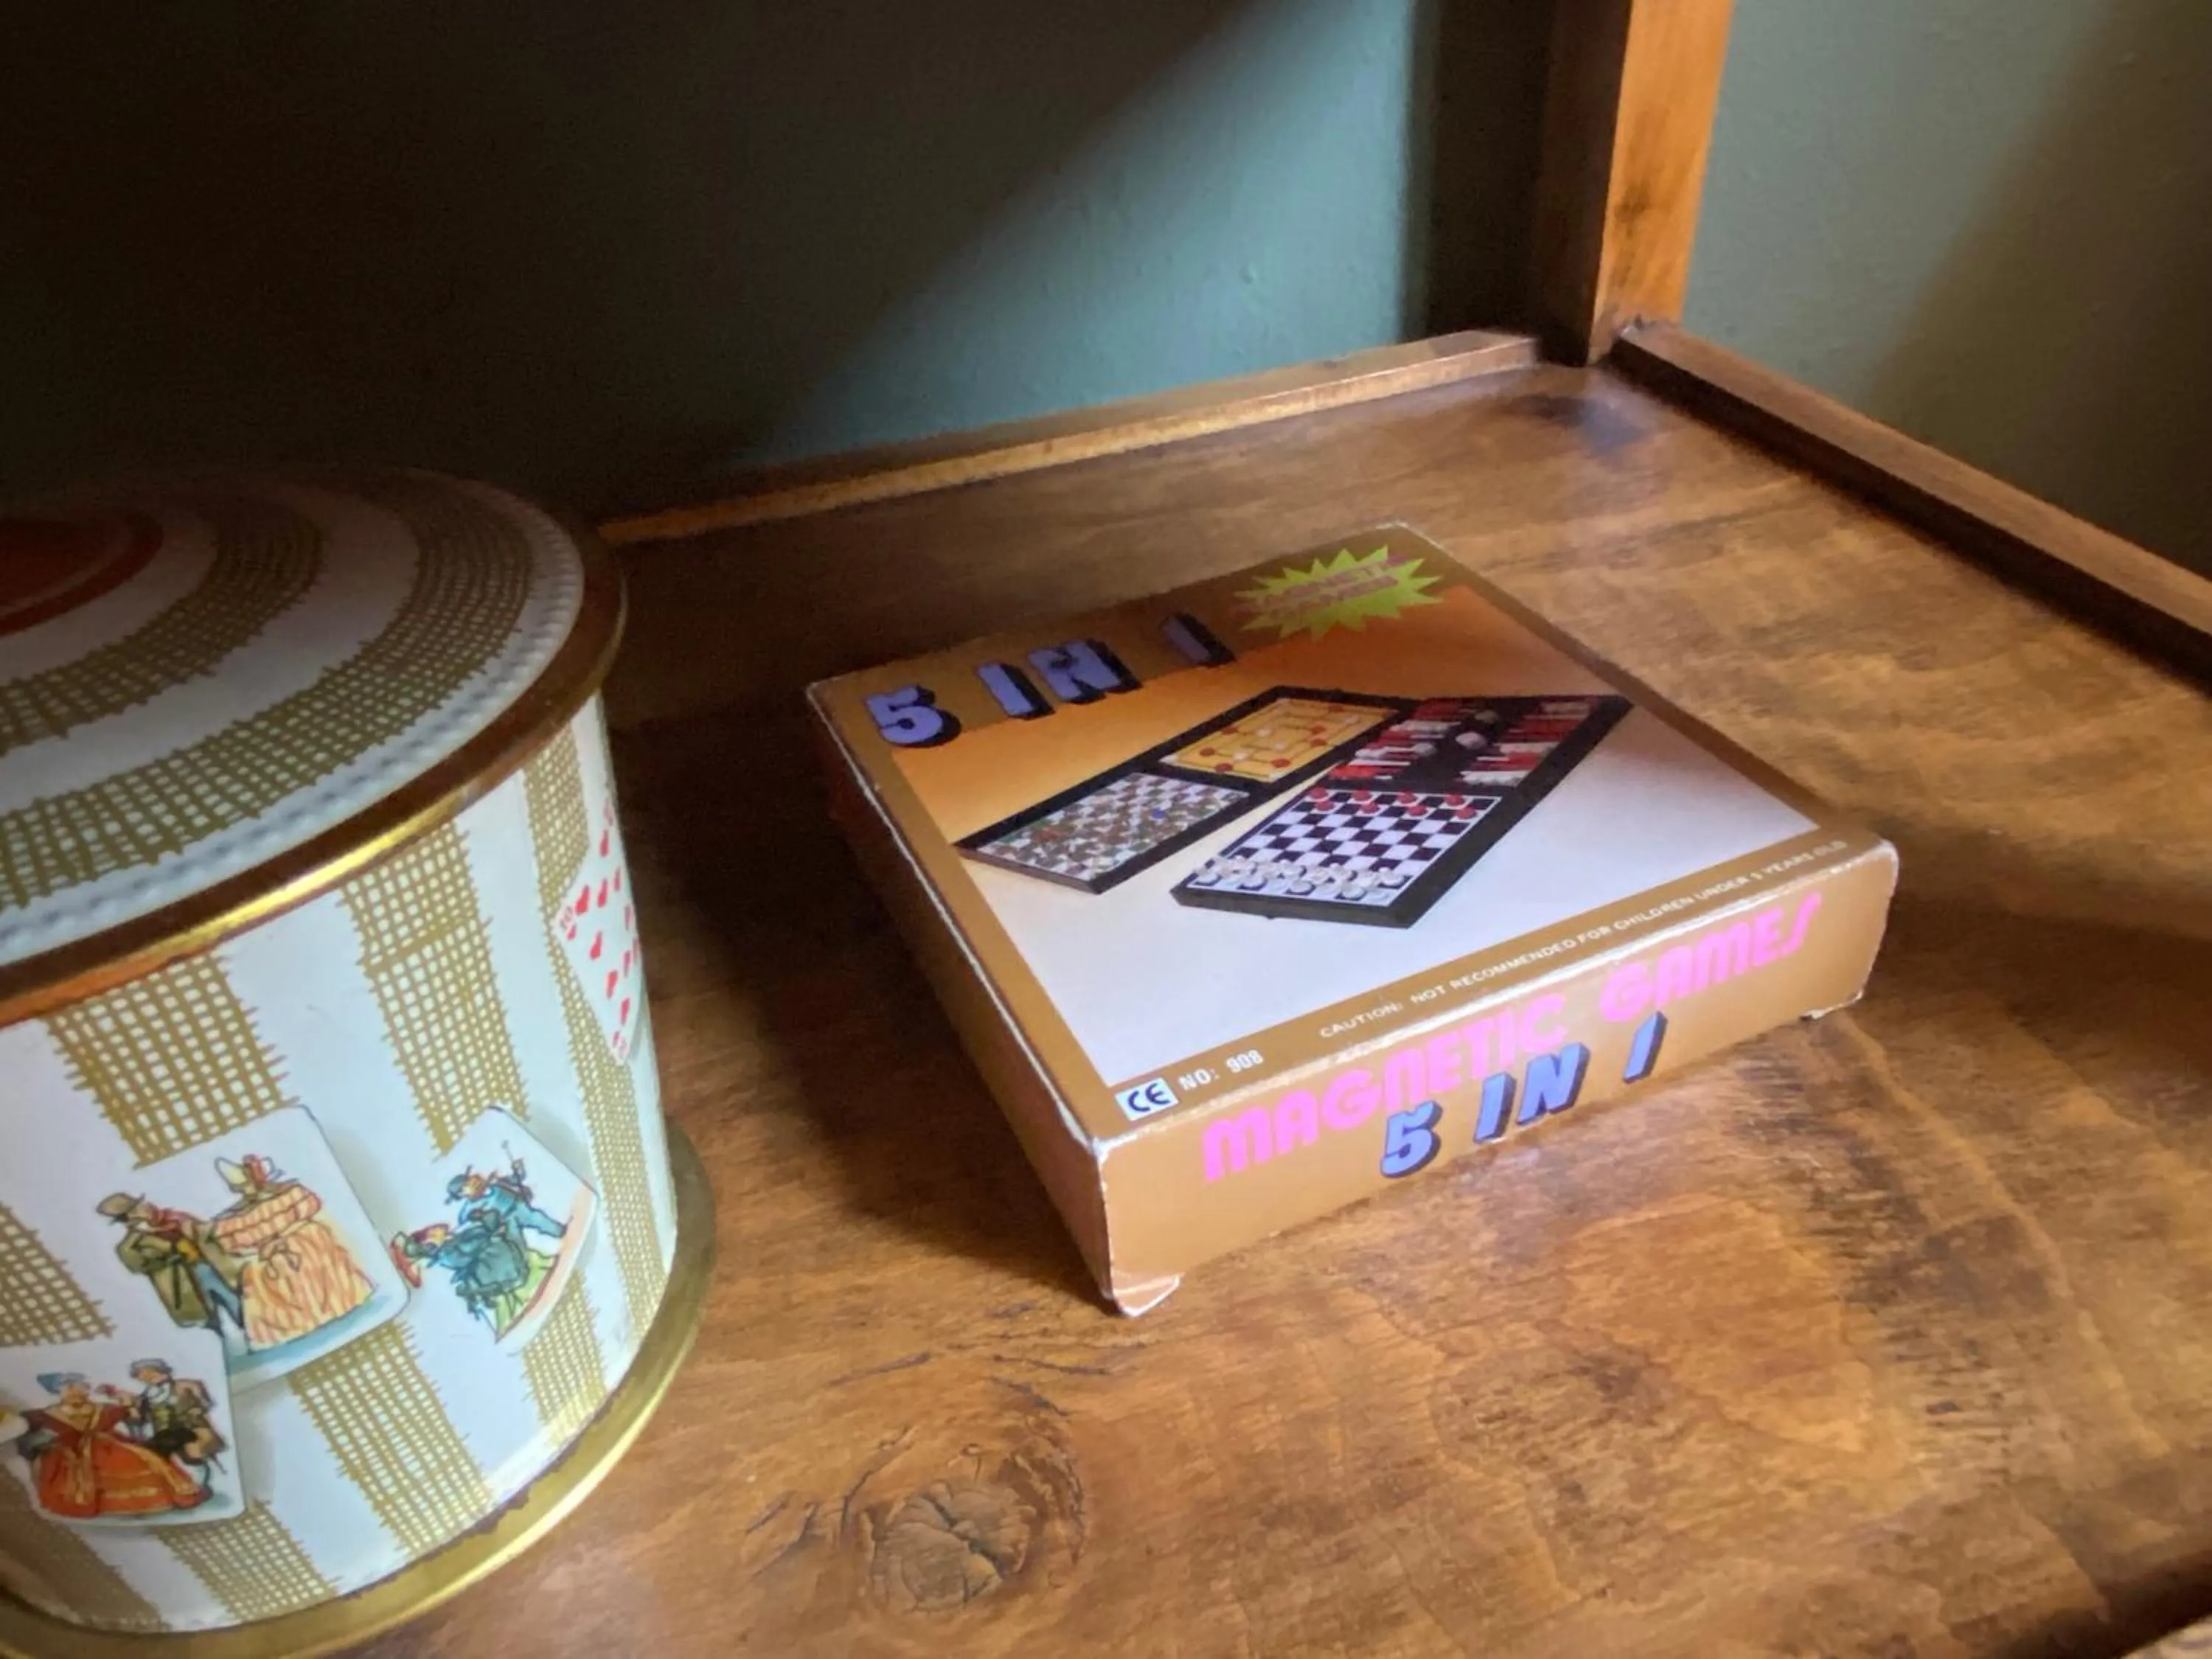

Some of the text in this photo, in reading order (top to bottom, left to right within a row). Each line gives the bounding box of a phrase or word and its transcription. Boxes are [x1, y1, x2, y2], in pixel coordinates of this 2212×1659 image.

[865, 685, 961, 749] 5
[976, 637, 1143, 720] IN
[1410, 984, 1446, 1004] NOT
[1449, 937, 1576, 990] RECOMMENDED
[1578, 925, 1612, 944] FOR
[1613, 896, 1694, 930] CHILDREN
[1694, 875, 1750, 900] UNDER
[1761, 853, 1815, 874] YEARS
[1128, 1083, 1171, 1113] CE
[1178, 1068, 1220, 1091] NO:
[1201, 891, 1822, 1183] MAGNETIC GAMES
[1380, 1100, 1443, 1178] 5
[1473, 1042, 1590, 1144] IN
